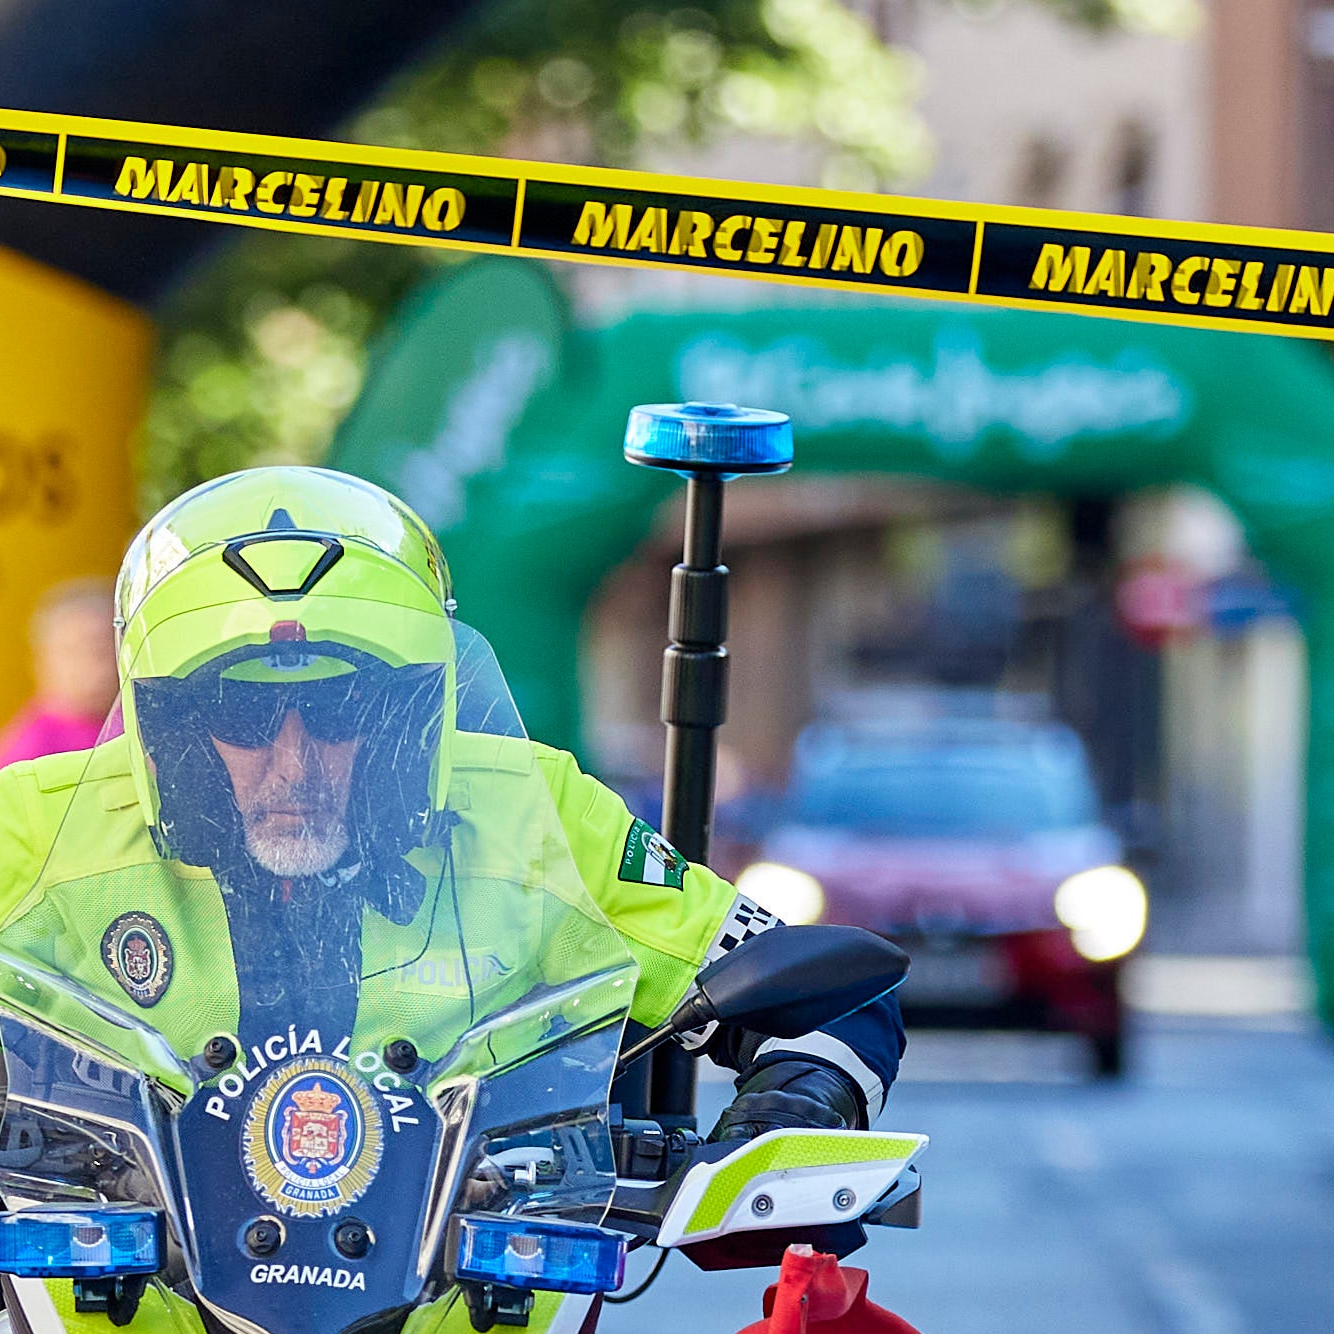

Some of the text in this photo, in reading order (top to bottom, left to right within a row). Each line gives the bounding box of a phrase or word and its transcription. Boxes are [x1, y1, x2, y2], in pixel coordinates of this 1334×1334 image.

[115, 156, 466, 232] MARCELINO
[571, 201, 925, 278] MARCELINO
[205, 1024, 419, 1133] POLICÍA LOCAL
[285, 1185, 336, 1200] GRANADA
[250, 1264, 366, 1291] GRANADA
